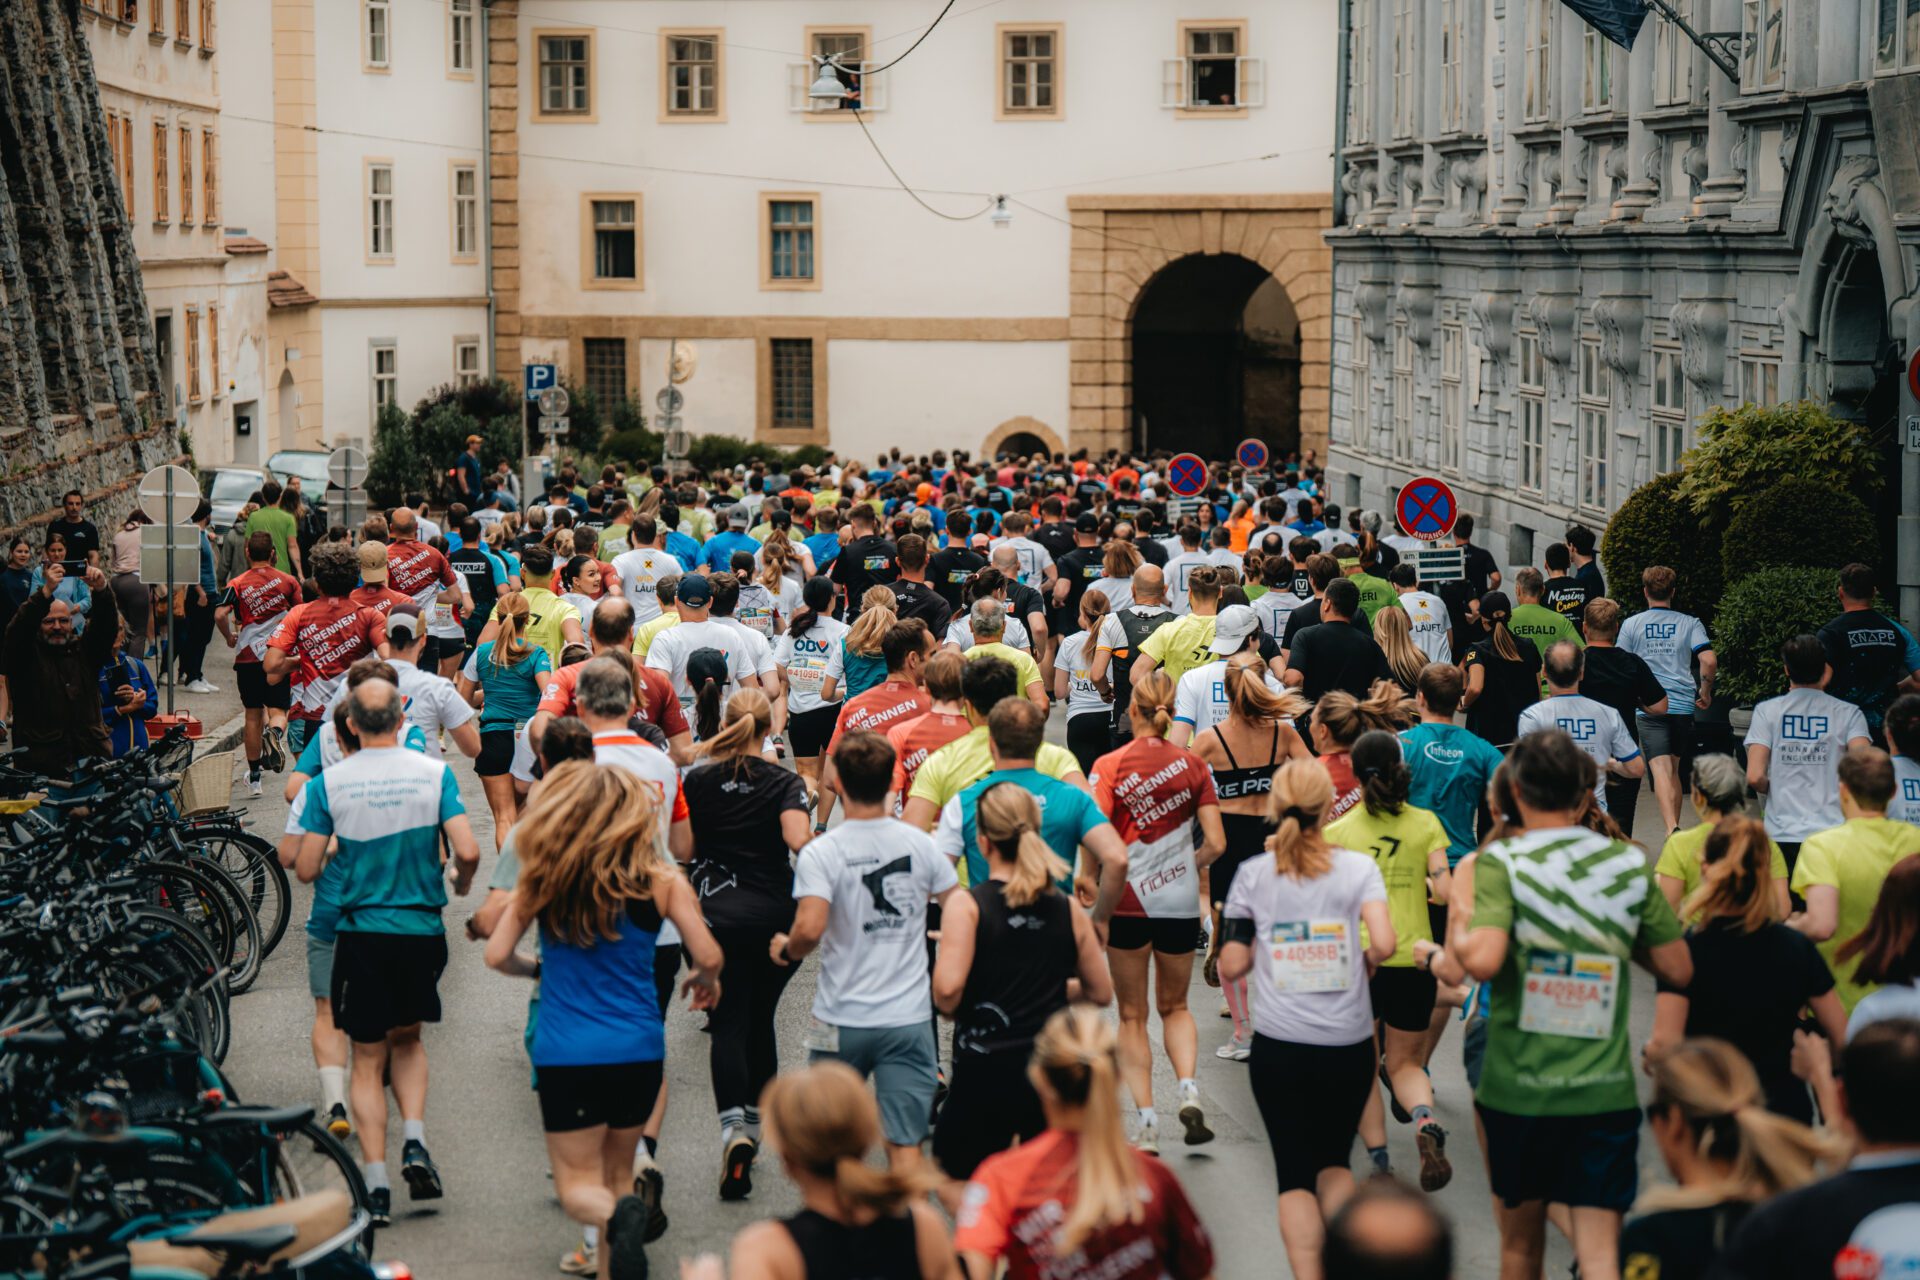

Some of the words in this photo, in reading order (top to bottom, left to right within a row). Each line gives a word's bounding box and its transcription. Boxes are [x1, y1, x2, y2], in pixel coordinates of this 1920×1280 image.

[533, 366, 548, 388] P
[1412, 529, 1445, 540] ANFANG
[388, 557, 403, 569] WIR
[451, 563, 485, 572] KNAPP
[395, 570, 411, 583] FÜR
[400, 567, 433, 590] STEUERN
[241, 585, 255, 599] WIR
[635, 584, 657, 593] LÄUF
[1547, 590, 1585, 604] Moving
[251, 593, 285, 617] STEUERN
[299, 624, 319, 640] WIR
[1415, 622, 1441, 632] LÄUFT
[1514, 625, 1556, 635] GERALD
[1848, 631, 1895, 645] KNAPP
[314, 635, 361, 669] STEUERN
[1077, 680, 1098, 692] LÄU
[846, 708, 868, 728] WIR
[903, 747, 929, 771] WIR
[1114, 772, 1142, 798] WIR
[1242, 778, 1272, 794] PR
[1130, 796, 1154, 818] FÜR
[1136, 788, 1192, 830] STEUERN
